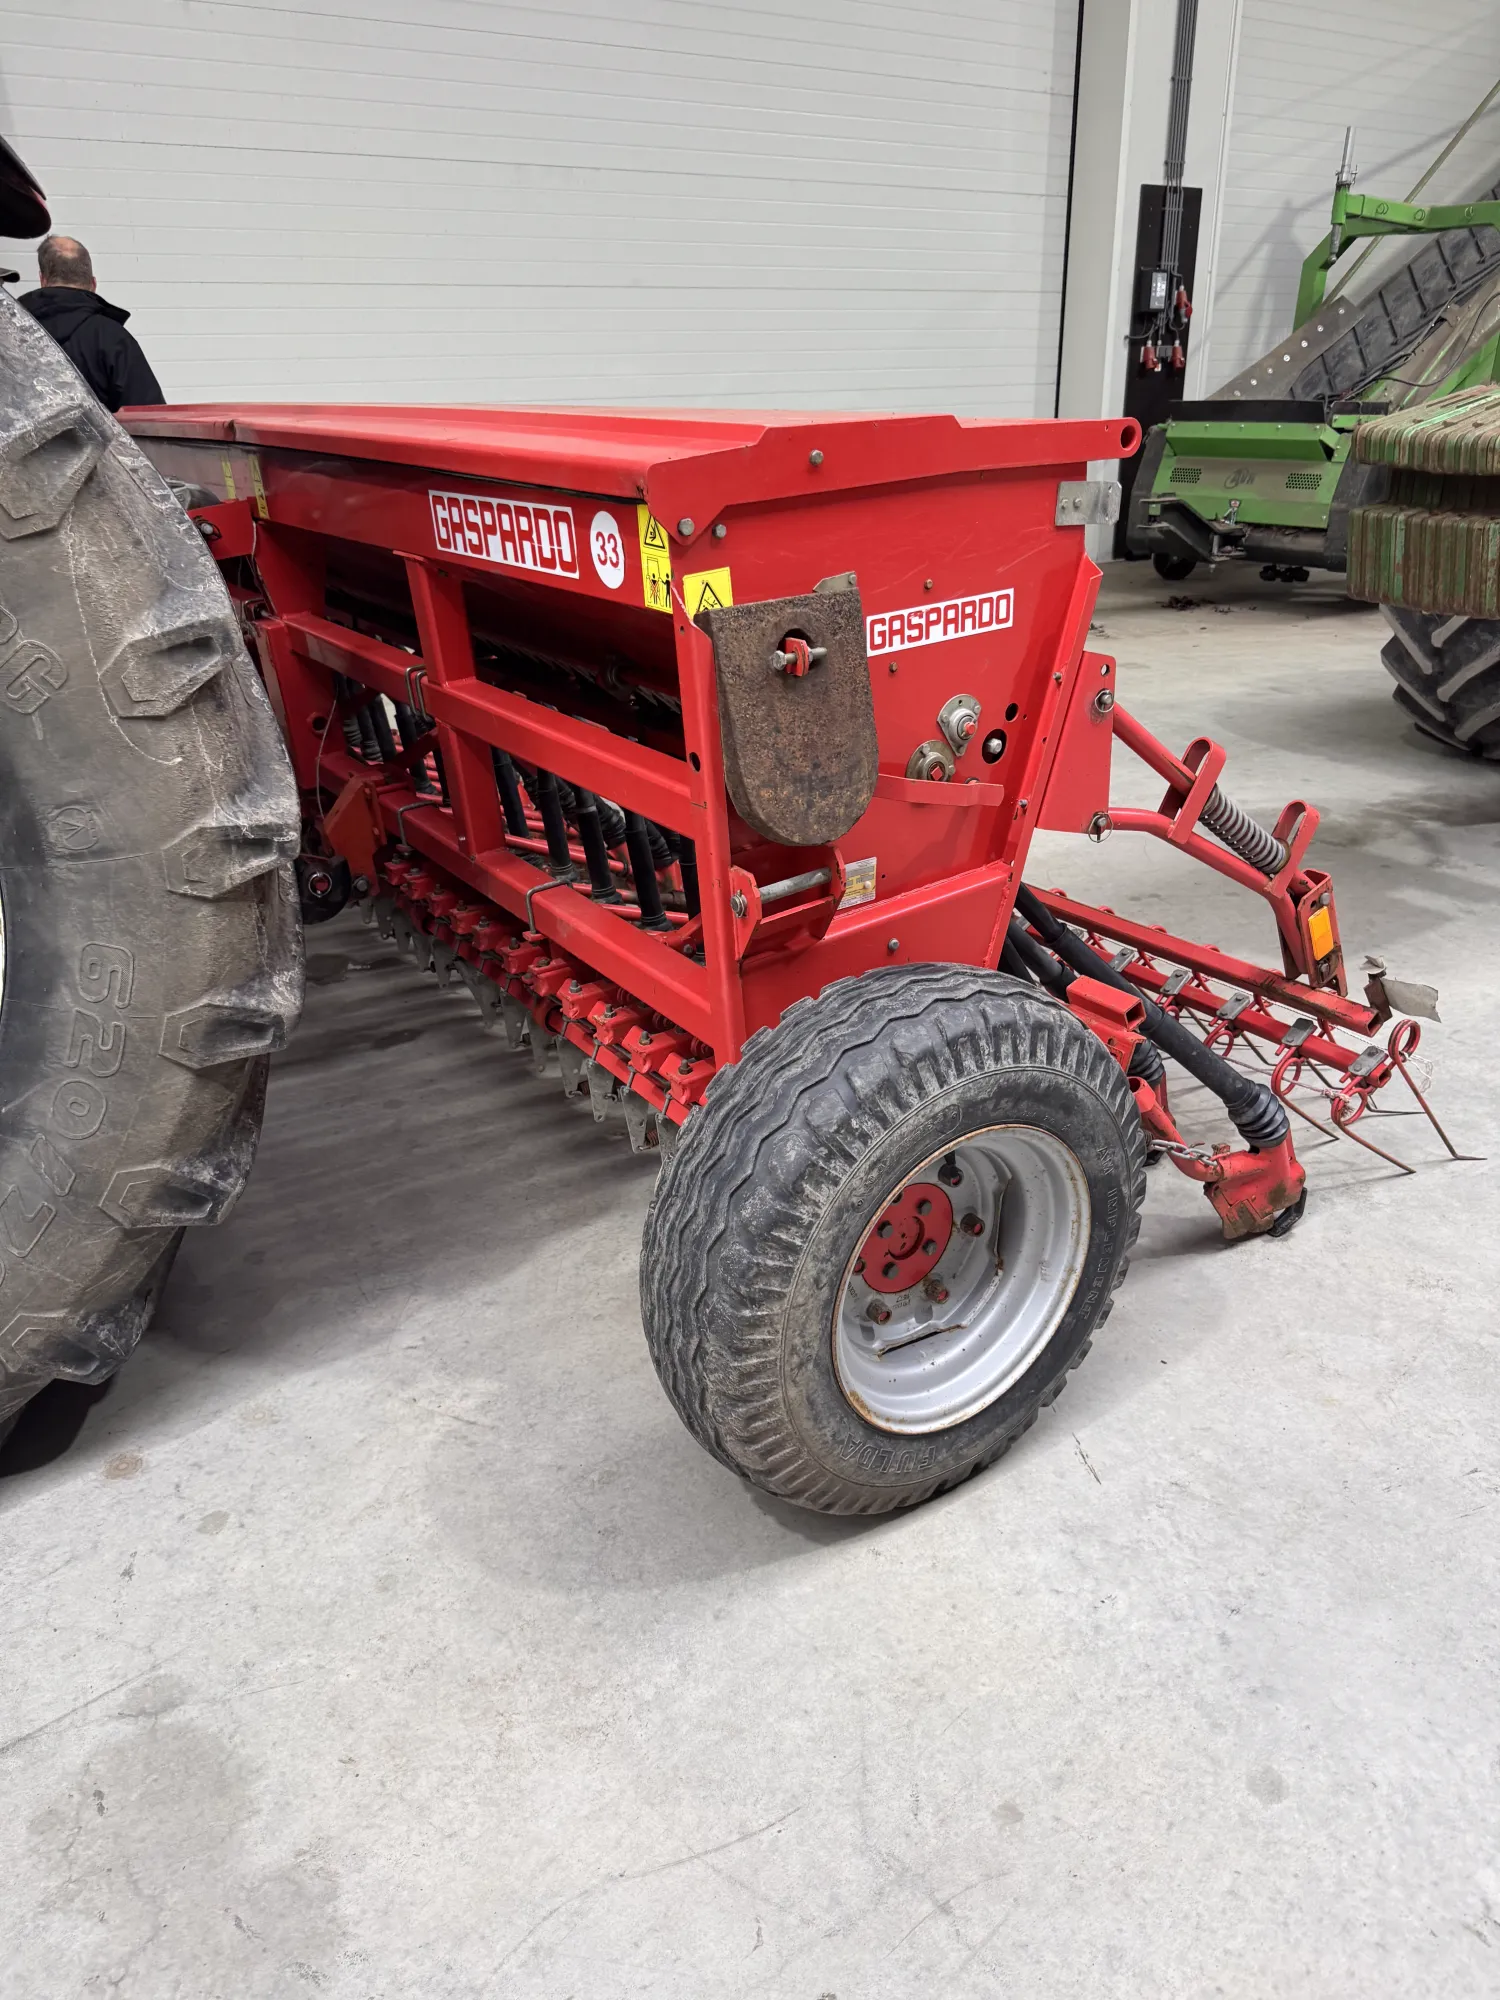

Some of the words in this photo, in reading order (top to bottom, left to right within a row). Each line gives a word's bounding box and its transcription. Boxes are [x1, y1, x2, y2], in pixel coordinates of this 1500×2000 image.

[431, 494, 578, 574] GASPARDO
[595, 530, 621, 569] 33
[869, 593, 1011, 651] GASPARDO
[1078, 1187, 1118, 1321] IMPLEMENT
[839, 1432, 936, 1474] FULDA
